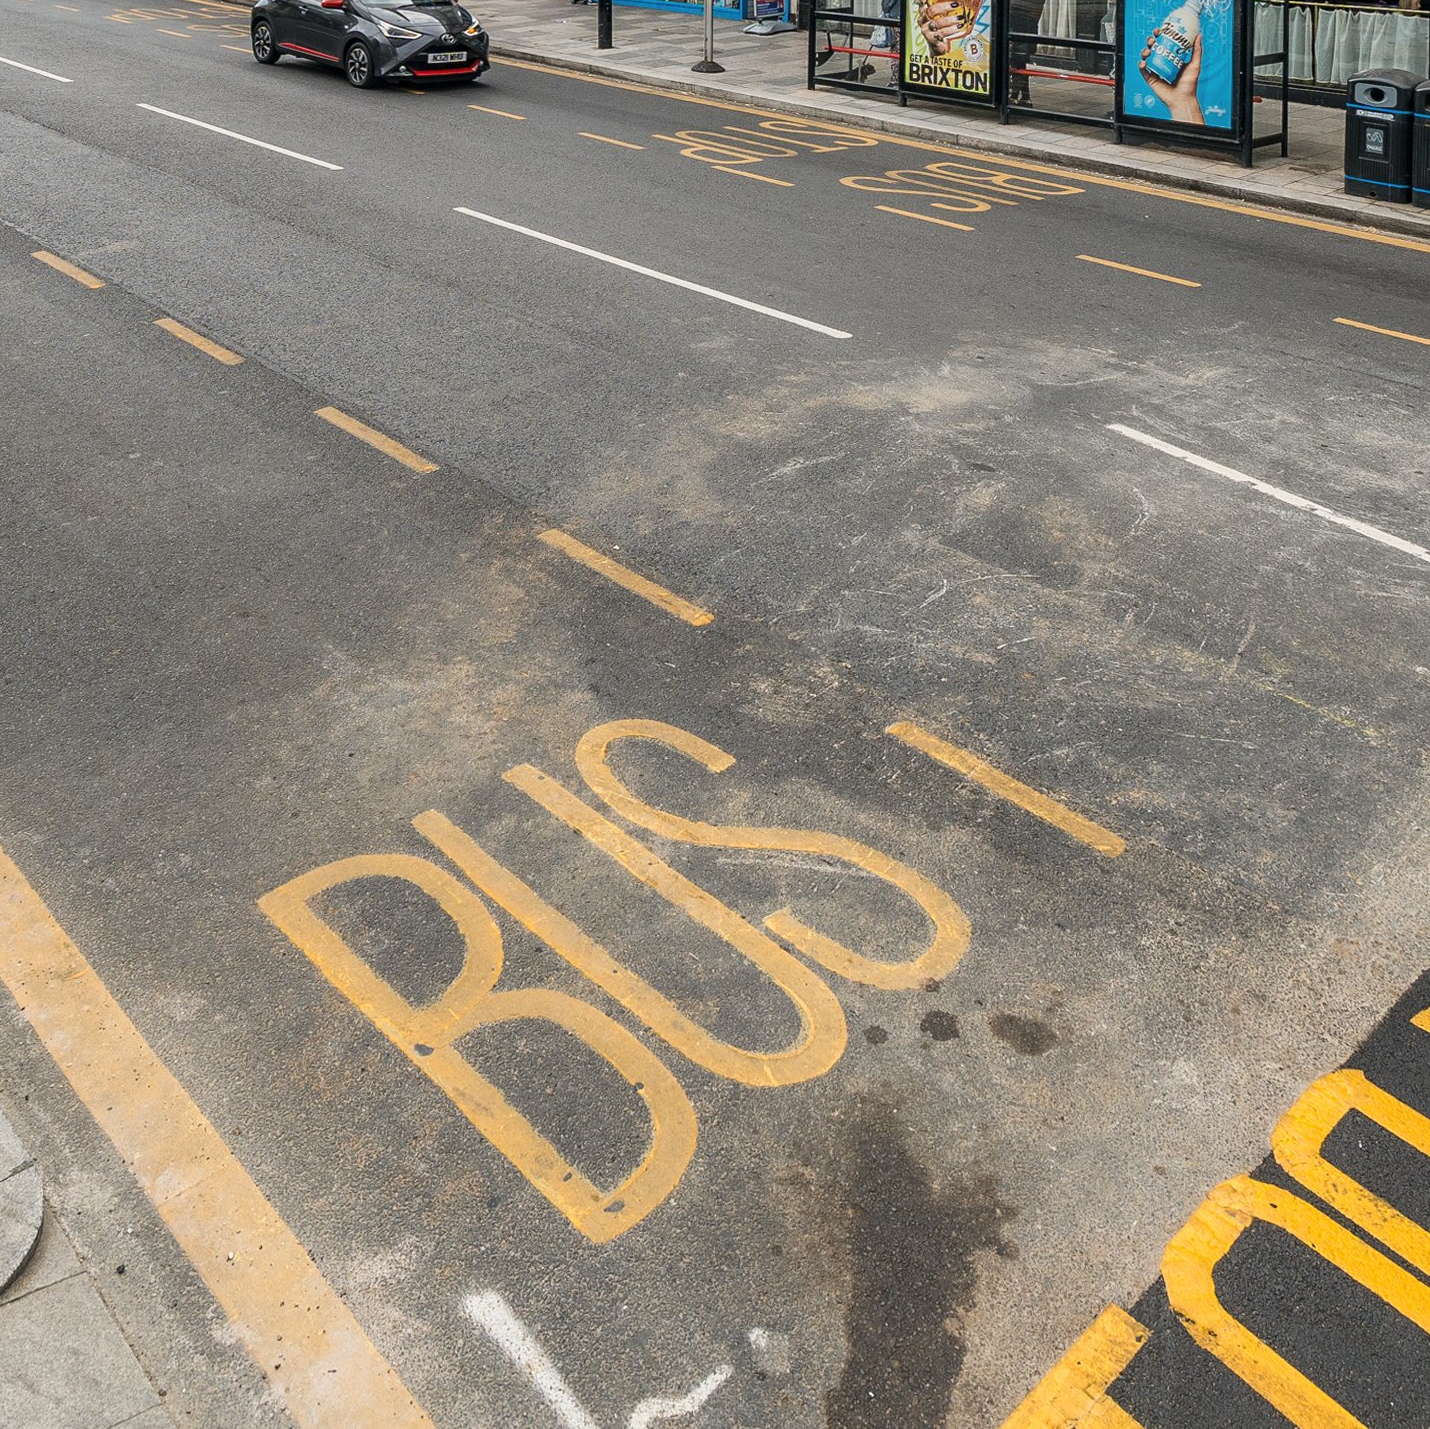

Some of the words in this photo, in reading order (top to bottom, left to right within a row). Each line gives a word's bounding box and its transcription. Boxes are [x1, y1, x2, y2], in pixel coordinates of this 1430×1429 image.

[909, 54, 923, 64] GET
[924, 56, 930, 64] A
[930, 56, 952, 68] TASTE
[953, 59, 963, 68] OF
[1151, 42, 1184, 69] COFFEE
[909, 62, 988, 93] BRIXTON
[651, 120, 878, 165] STOP
[839, 161, 1086, 213] BUS
[256, 717, 974, 1244] BUS
